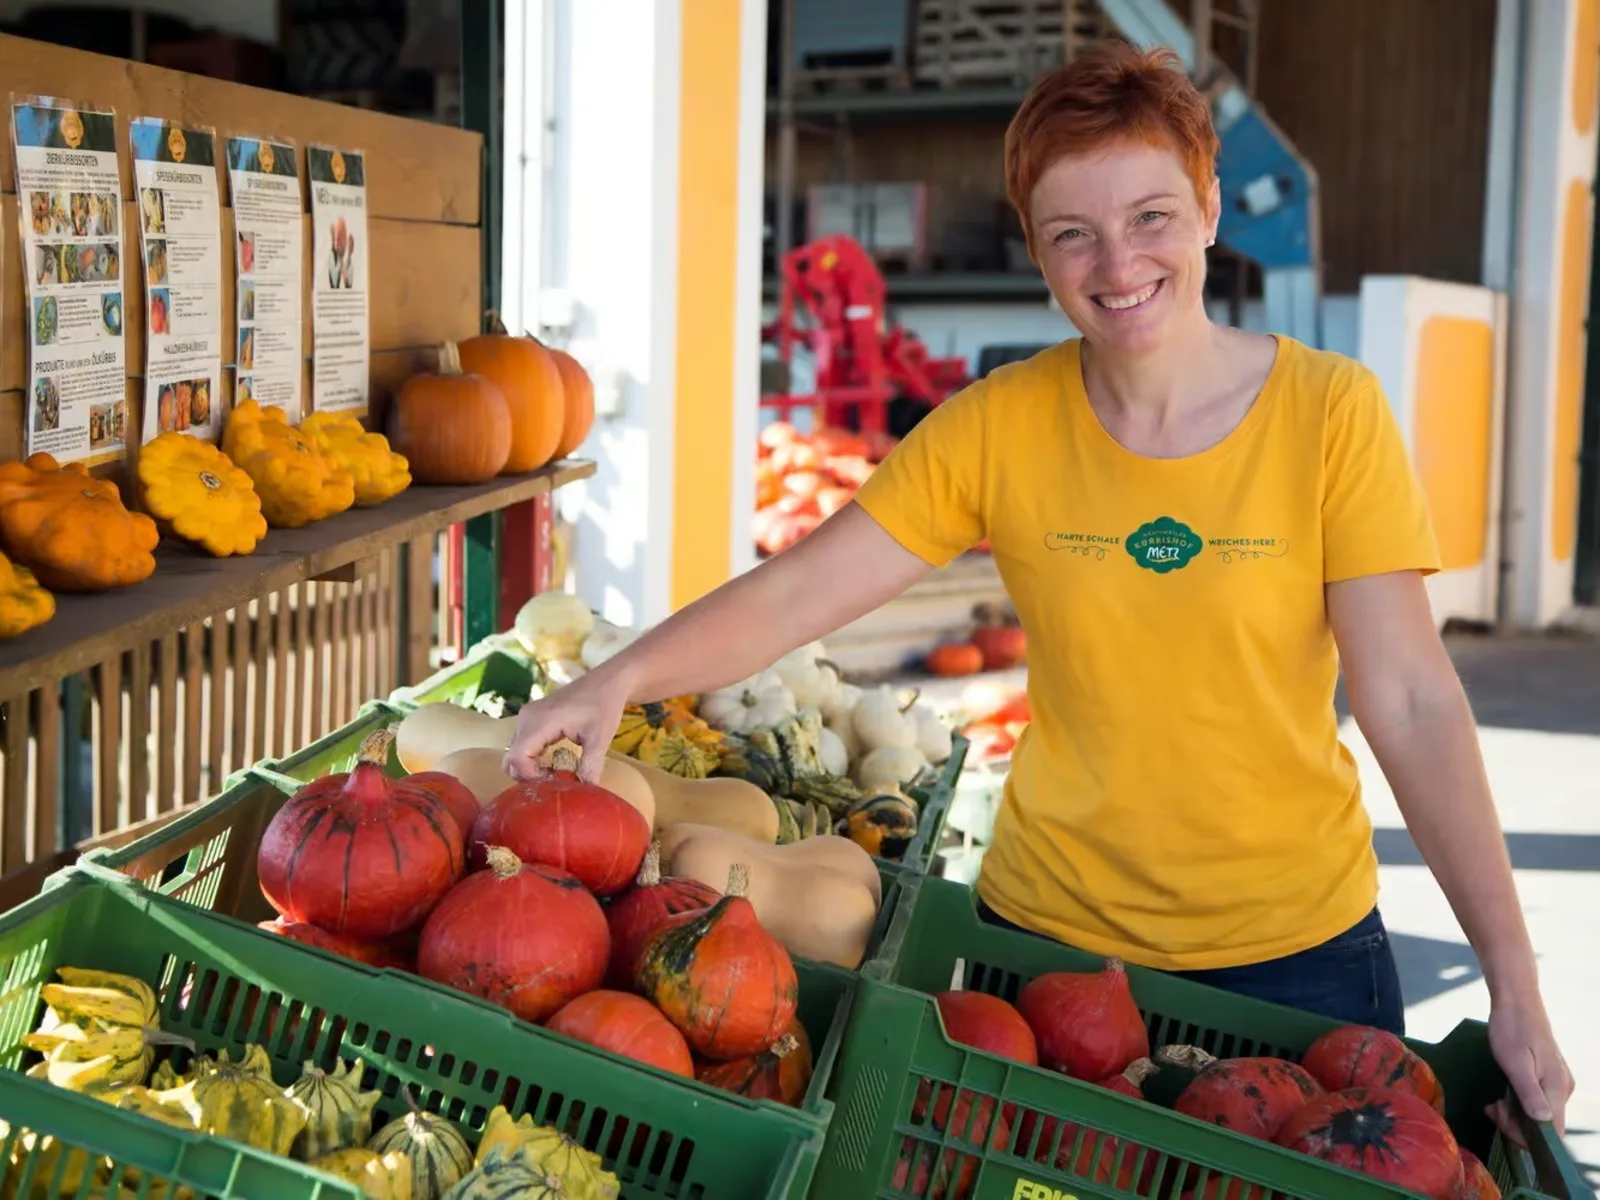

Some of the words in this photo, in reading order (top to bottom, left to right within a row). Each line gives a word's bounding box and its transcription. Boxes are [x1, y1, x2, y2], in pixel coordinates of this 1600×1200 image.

[35, 359, 64, 373] PRODUKTE
[1056, 533, 1083, 542] HARTE
[1086, 534, 1120, 544] SCHALE
[1208, 538, 1251, 546] WEICHES
[1253, 538, 1276, 546] HERZ
[1146, 546, 1180, 560] METZ
